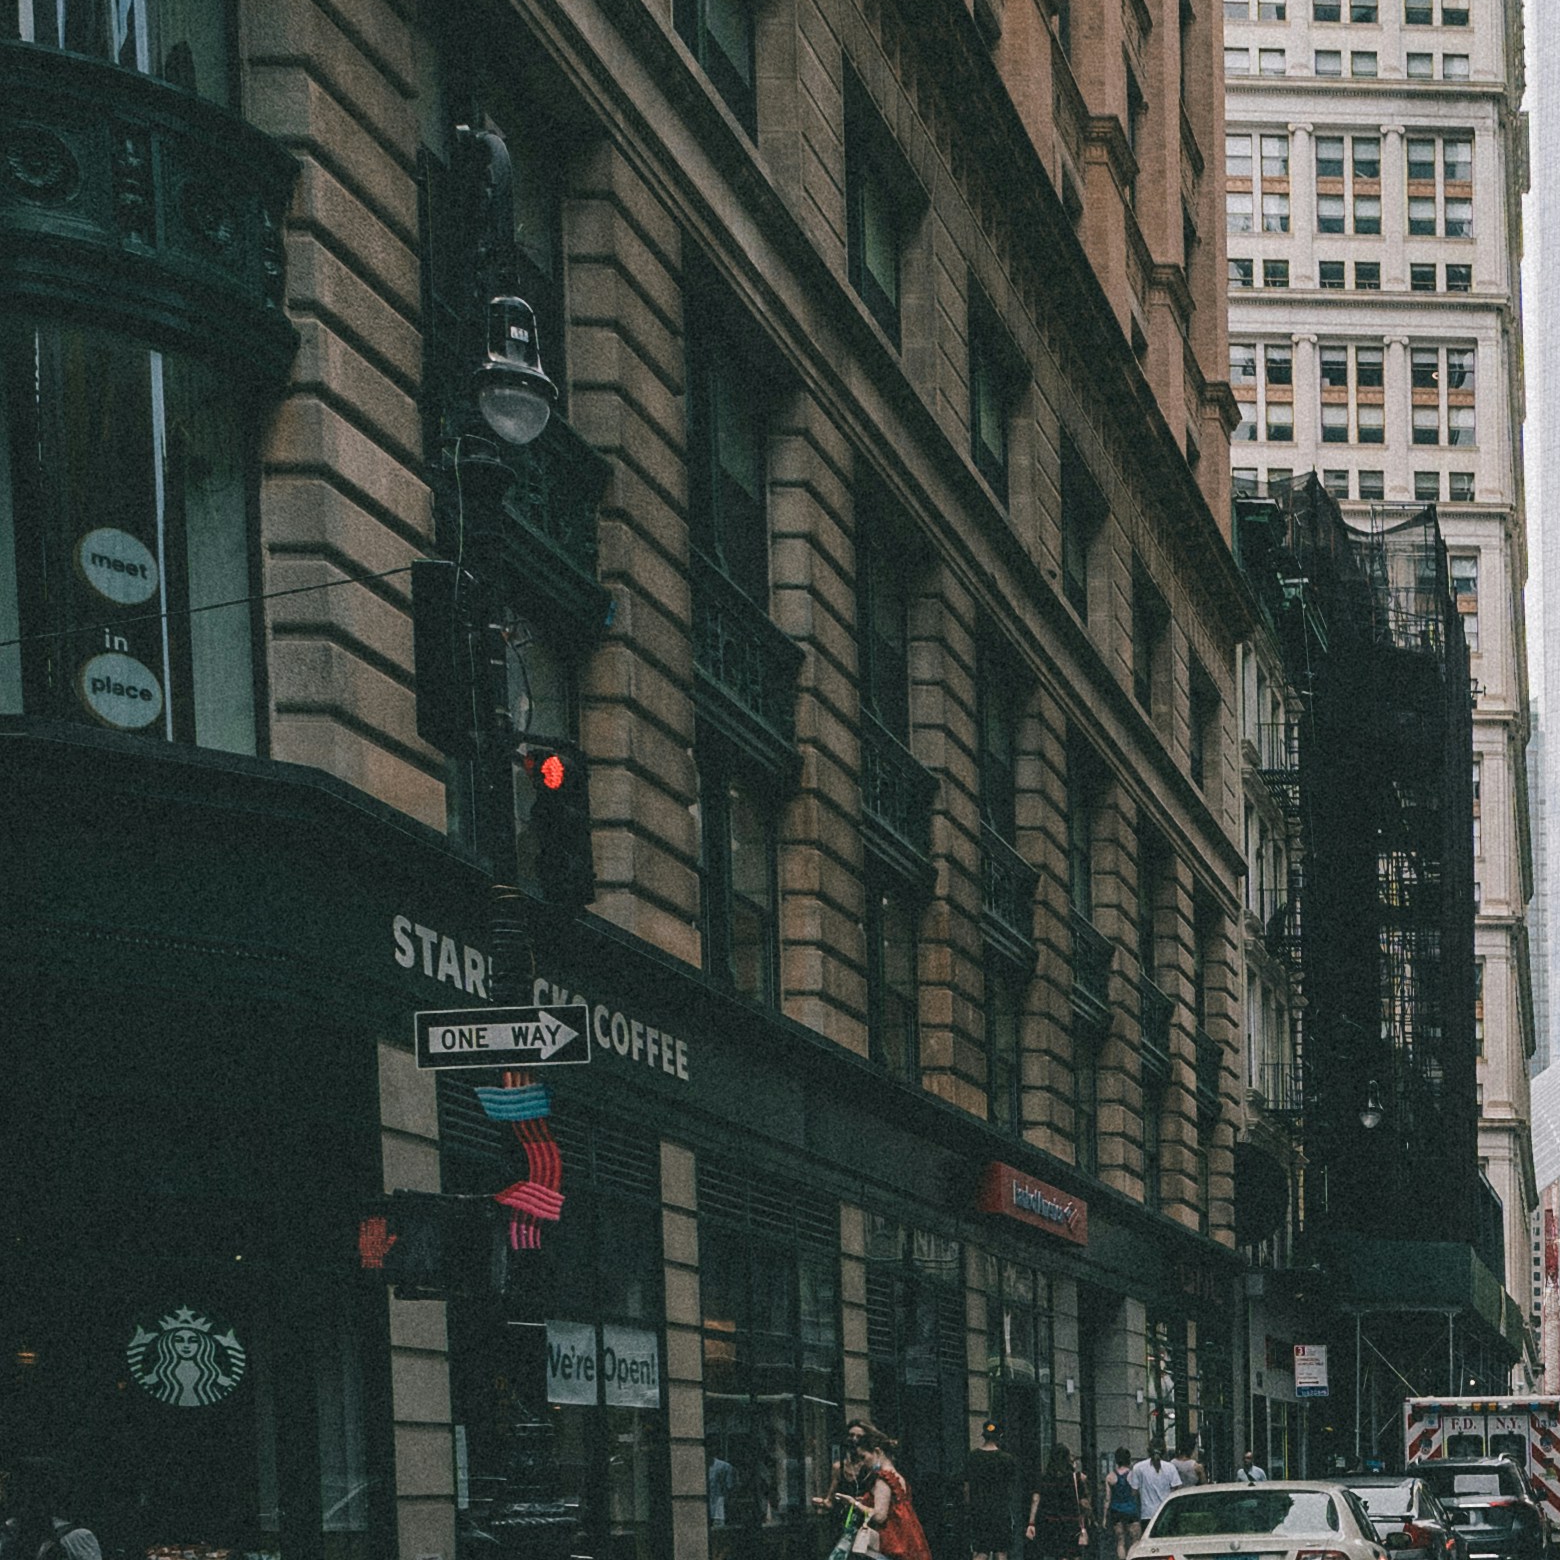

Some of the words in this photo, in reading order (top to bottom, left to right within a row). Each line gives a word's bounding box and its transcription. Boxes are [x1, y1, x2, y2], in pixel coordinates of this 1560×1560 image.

[90, 551, 148, 580] meet
[104, 628, 128, 652] in
[90, 676, 153, 703] place
[391, 913, 586, 1006] STARCK
[593, 1004, 690, 1082] COFFEE
[441, 1027, 489, 1050] ONE
[511, 1024, 563, 1048] WAY
[603, 1346, 657, 1390] Open!
[1451, 1418, 1477, 1430] F.D.
[1496, 1417, 1521, 1430] N.Y.
